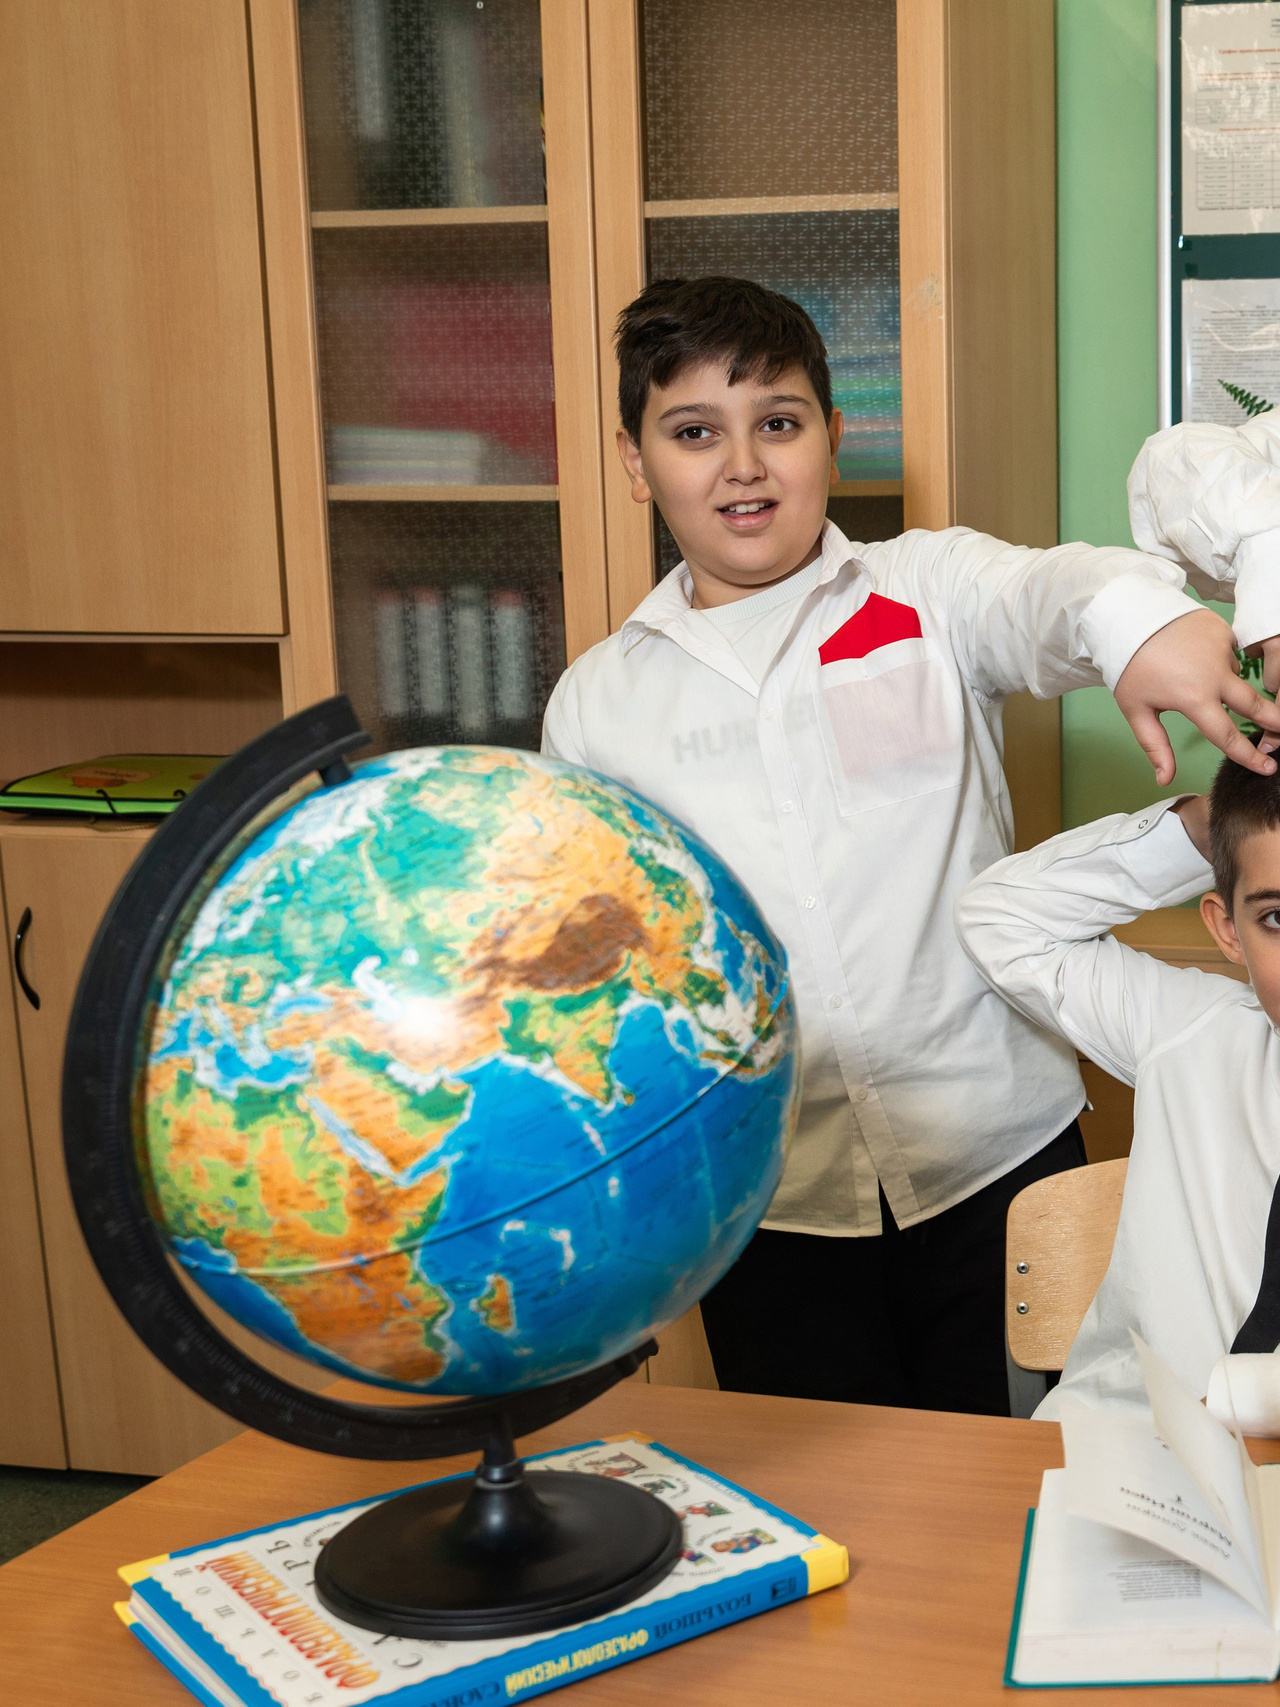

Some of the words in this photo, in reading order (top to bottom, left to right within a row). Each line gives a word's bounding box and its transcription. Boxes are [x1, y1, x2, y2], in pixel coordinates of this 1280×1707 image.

[194, 1550, 381, 1690] ФРАЗЕОЛОГИЧЕСКИЙ
[654, 1589, 753, 1643] БОЛЬШОЙ
[505, 1628, 649, 1698] ФРАЗЕОЛОГИЧЕСКИЙ
